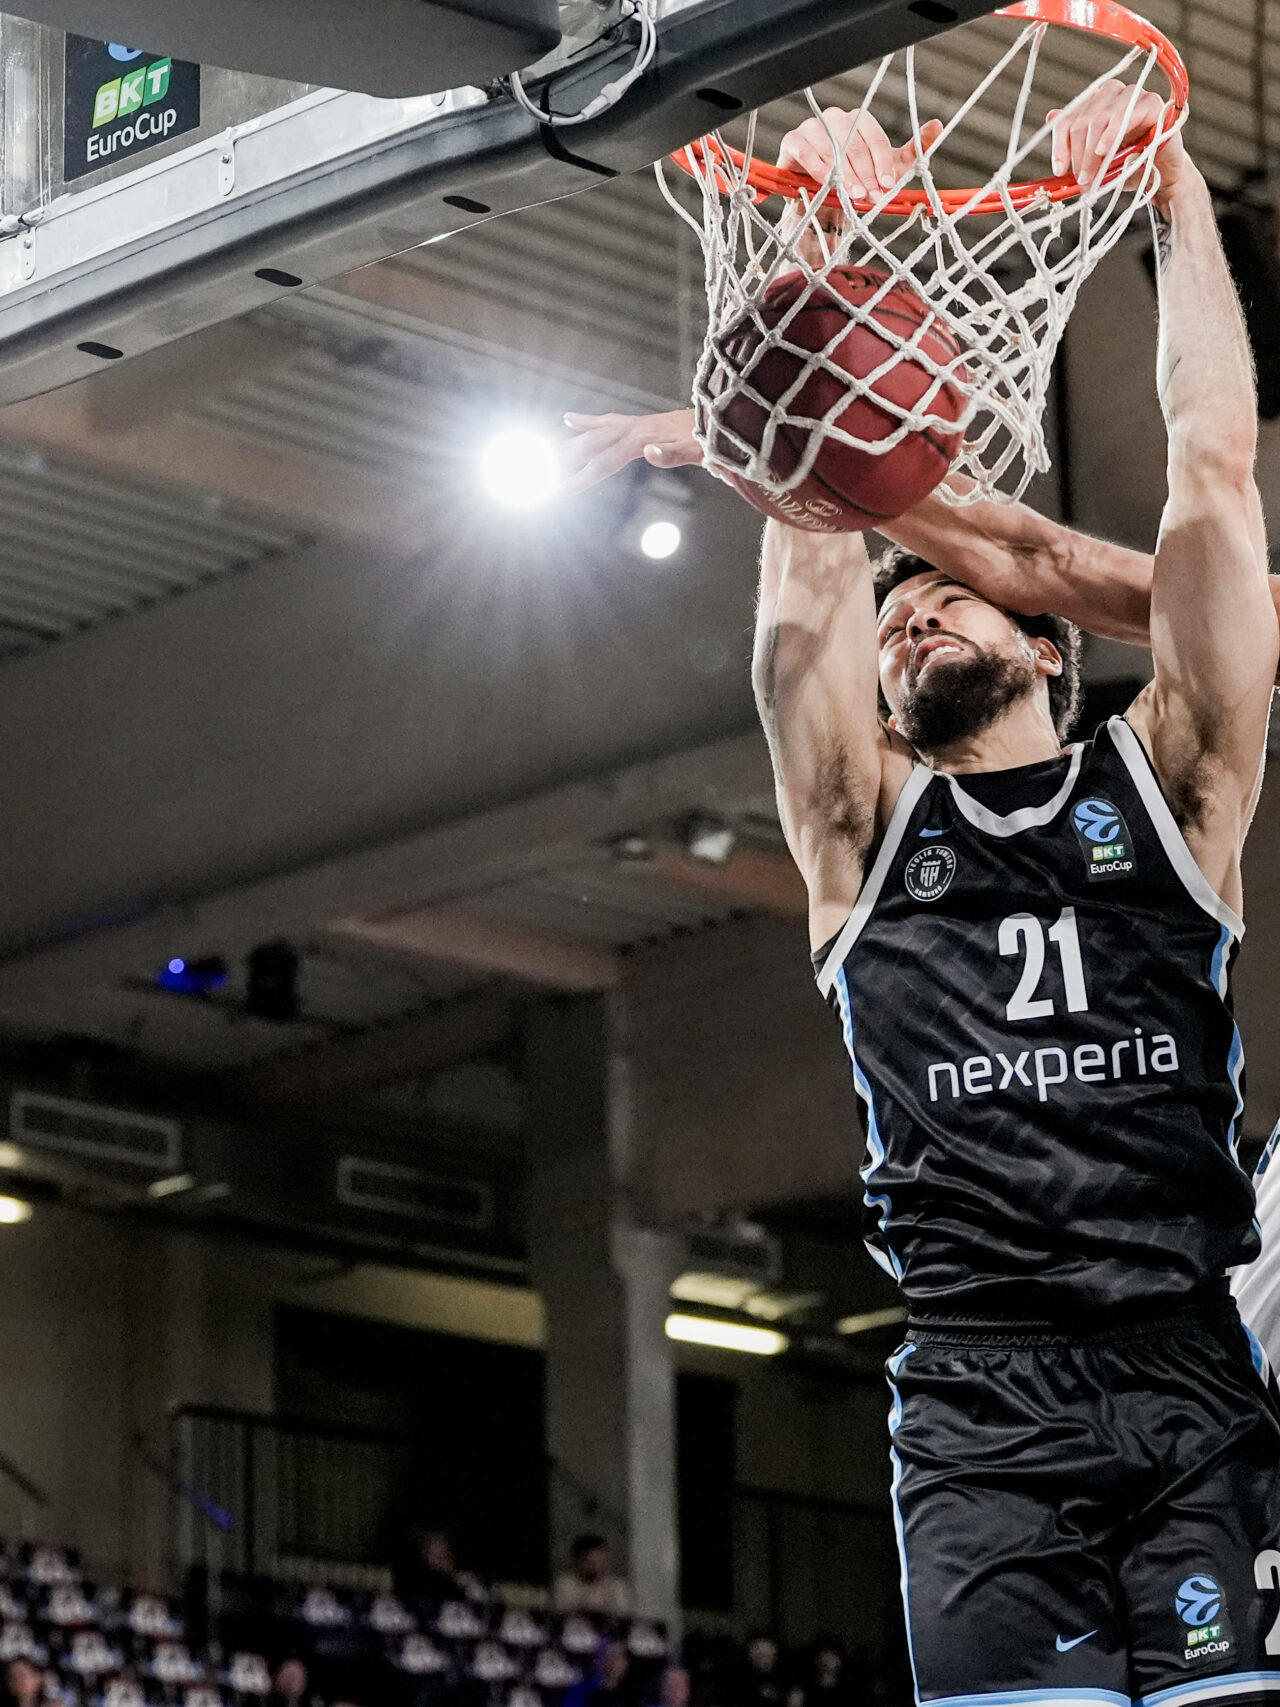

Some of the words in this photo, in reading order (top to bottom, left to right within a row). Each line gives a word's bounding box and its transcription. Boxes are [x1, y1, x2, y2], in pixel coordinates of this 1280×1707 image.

[94, 62, 170, 122] BKT
[86, 108, 177, 162] EuroCup
[908, 849, 932, 873] VEOLIA
[1093, 845, 1124, 859] BKT
[1090, 860, 1133, 874] EuroCup
[997, 906, 1089, 1022] 21
[927, 1027, 1180, 1102] nexperia
[1187, 1624, 1220, 1644] BKT
[1184, 1639, 1230, 1660] EuroCup
